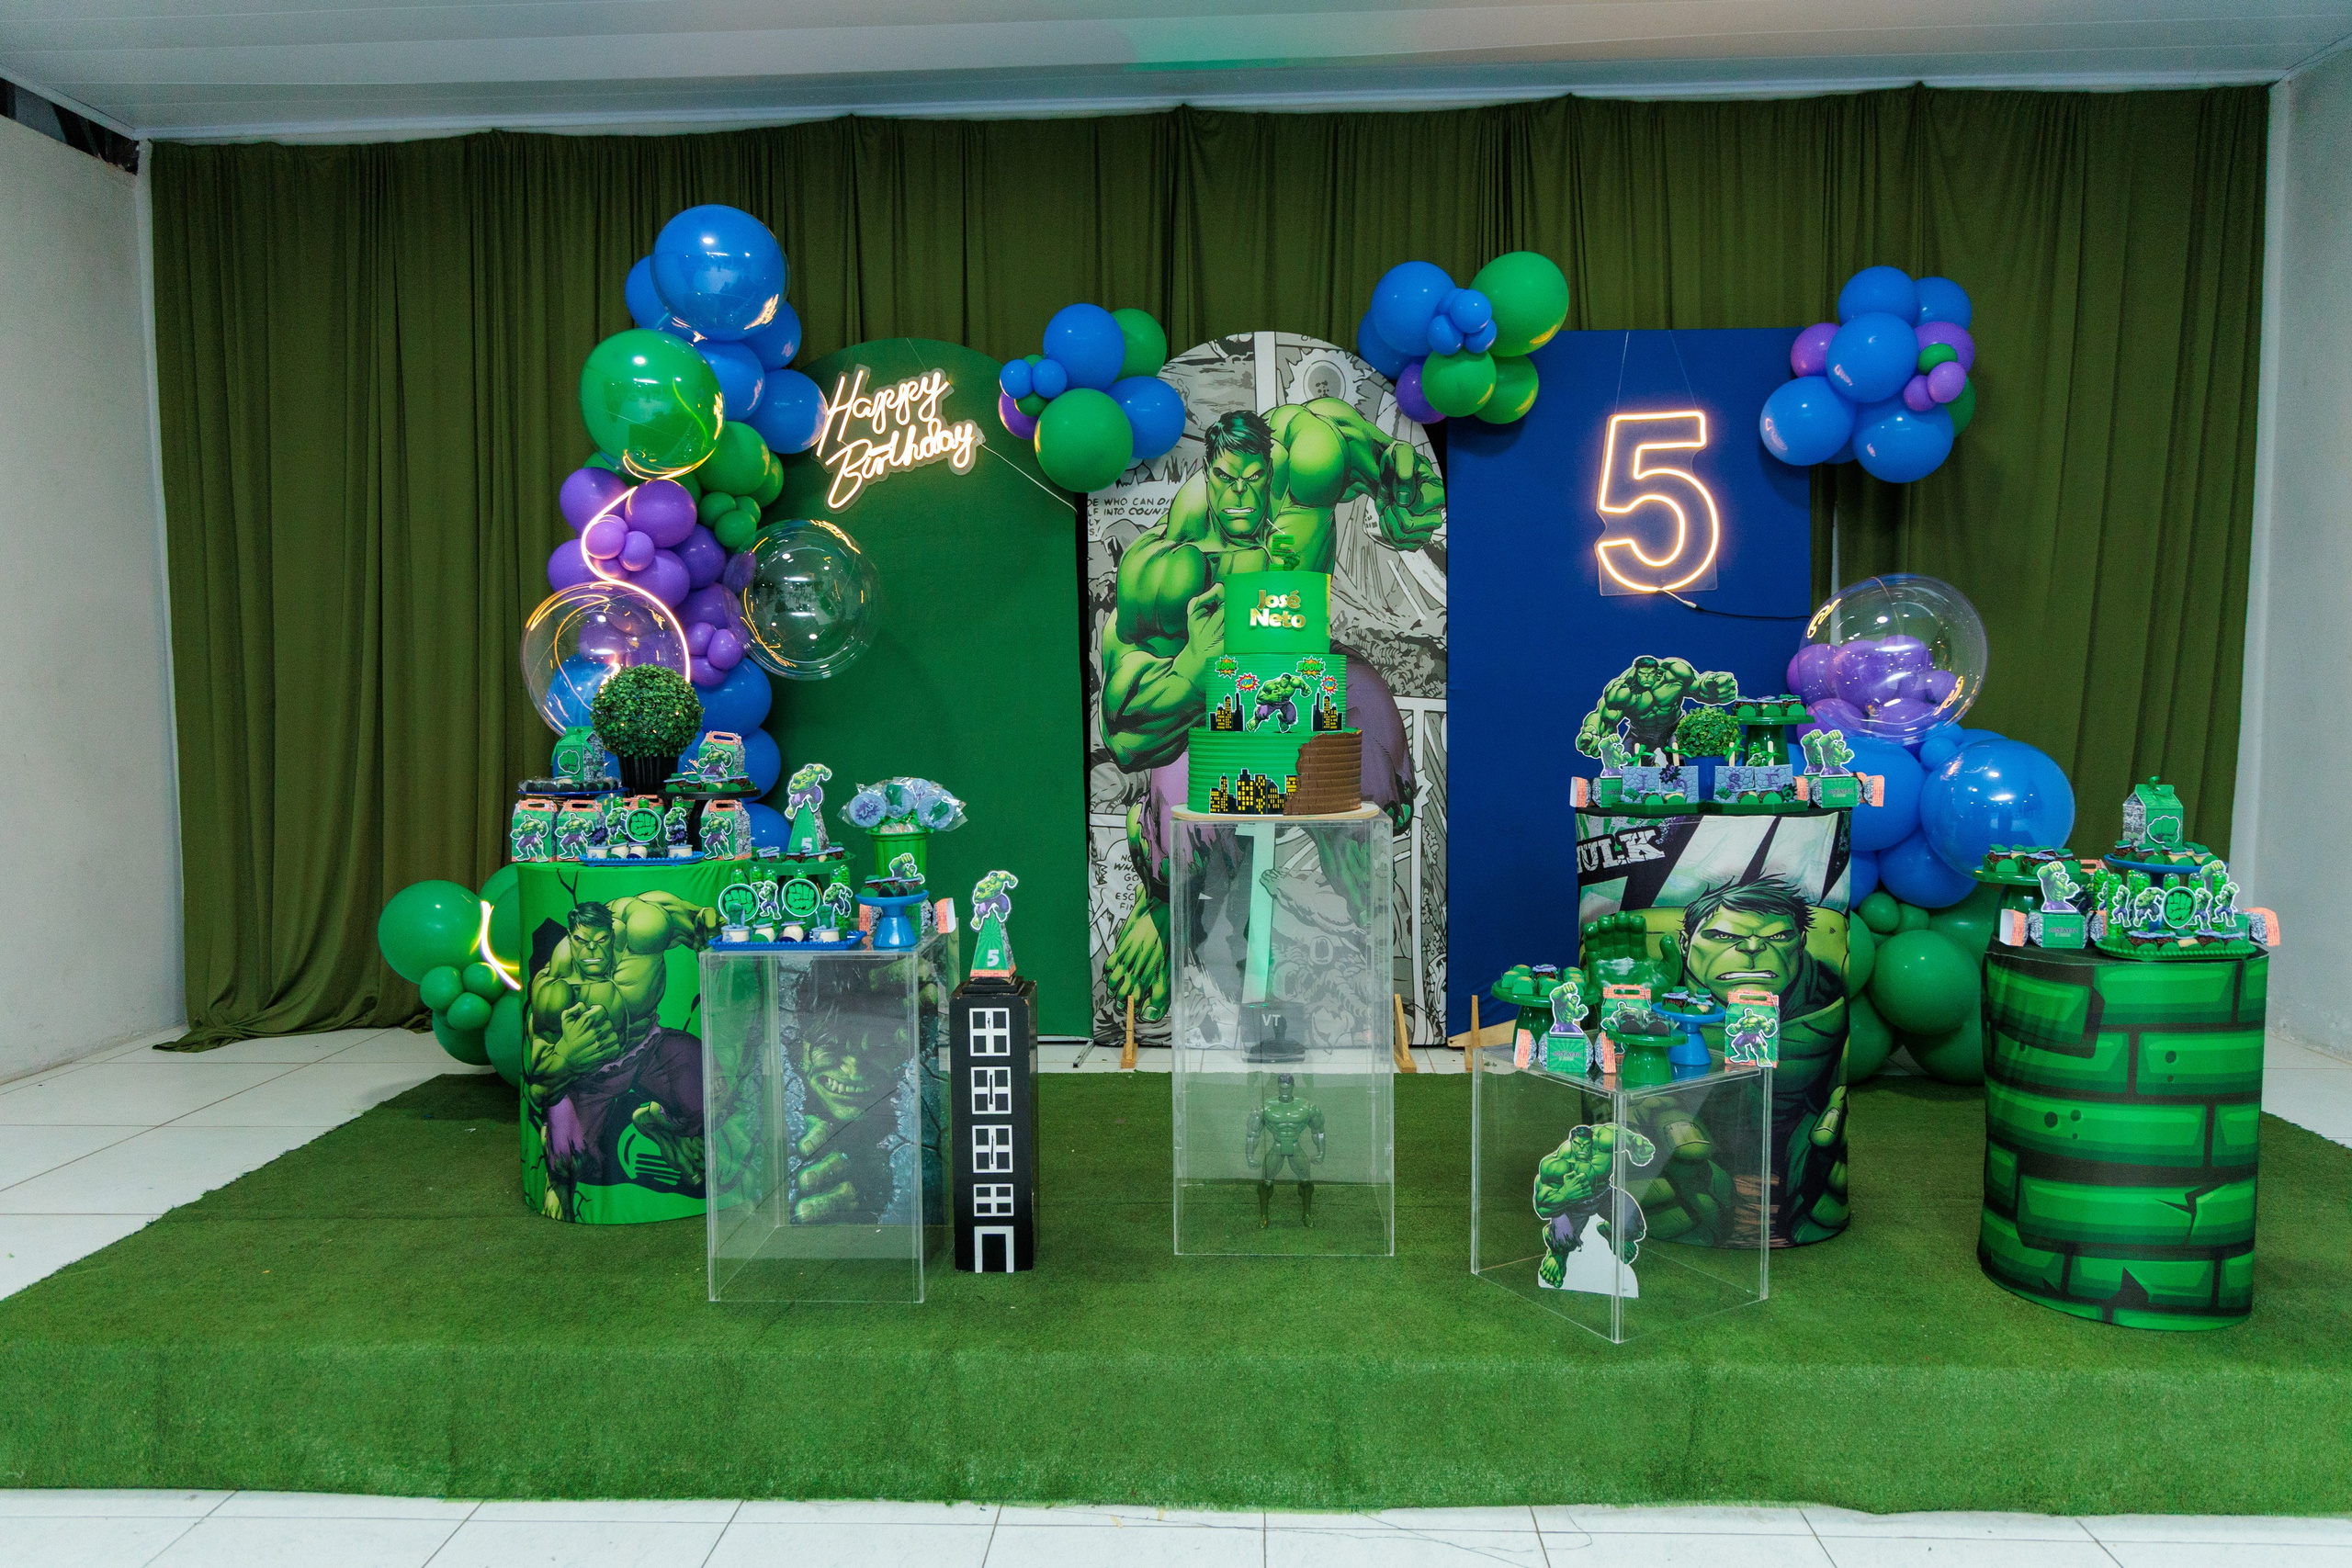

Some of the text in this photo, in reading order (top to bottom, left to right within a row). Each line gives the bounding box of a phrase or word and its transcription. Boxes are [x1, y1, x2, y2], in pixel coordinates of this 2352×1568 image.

[816, 368, 950, 457] Happy
[825, 418, 977, 509] Birthday
[1103, 507, 1125, 515] INTO
[1104, 497, 1128, 506] WHO
[1132, 497, 1154, 506] CAN
[1597, 411, 1719, 592] 5
[1257, 589, 1301, 610] José
[1250, 607, 1306, 629] Neto
[987, 949, 1000, 967] 5
